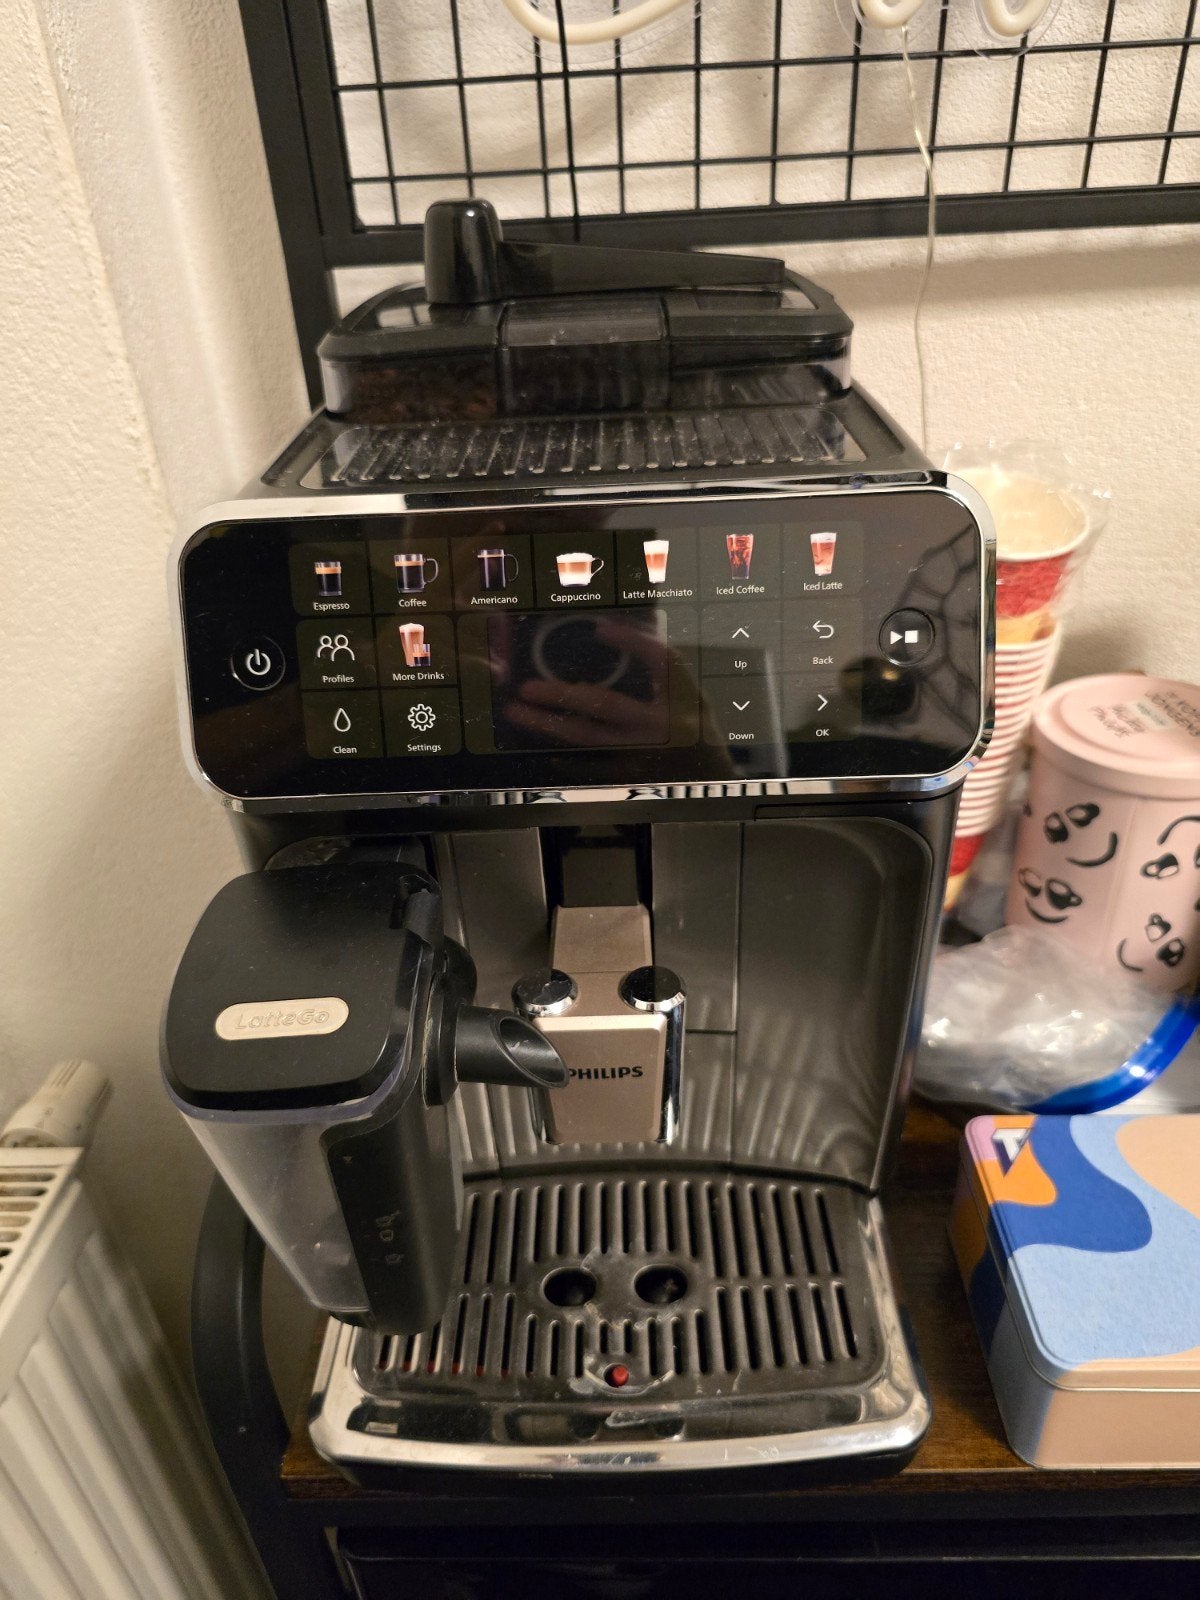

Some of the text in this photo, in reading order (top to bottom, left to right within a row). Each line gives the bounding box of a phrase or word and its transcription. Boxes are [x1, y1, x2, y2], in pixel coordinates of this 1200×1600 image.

[716, 584, 765, 595] Iced Coffee
[803, 581, 843, 591] Iced Latte
[550, 592, 601, 603] Cappuccino
[623, 588, 693, 599] Latte Macchiato
[398, 598, 427, 608] Coffee
[470, 595, 518, 605] Americano
[313, 602, 350, 612] Espresso
[734, 660, 748, 670] Up
[812, 656, 834, 665] Back
[322, 674, 355, 683] Profiles
[392, 671, 445, 681] More Drinks
[728, 732, 755, 740] Down
[815, 729, 830, 737] OK
[333, 745, 358, 754] Clean
[407, 743, 442, 753] Settings
[235, 1008, 330, 1030] LatteGo
